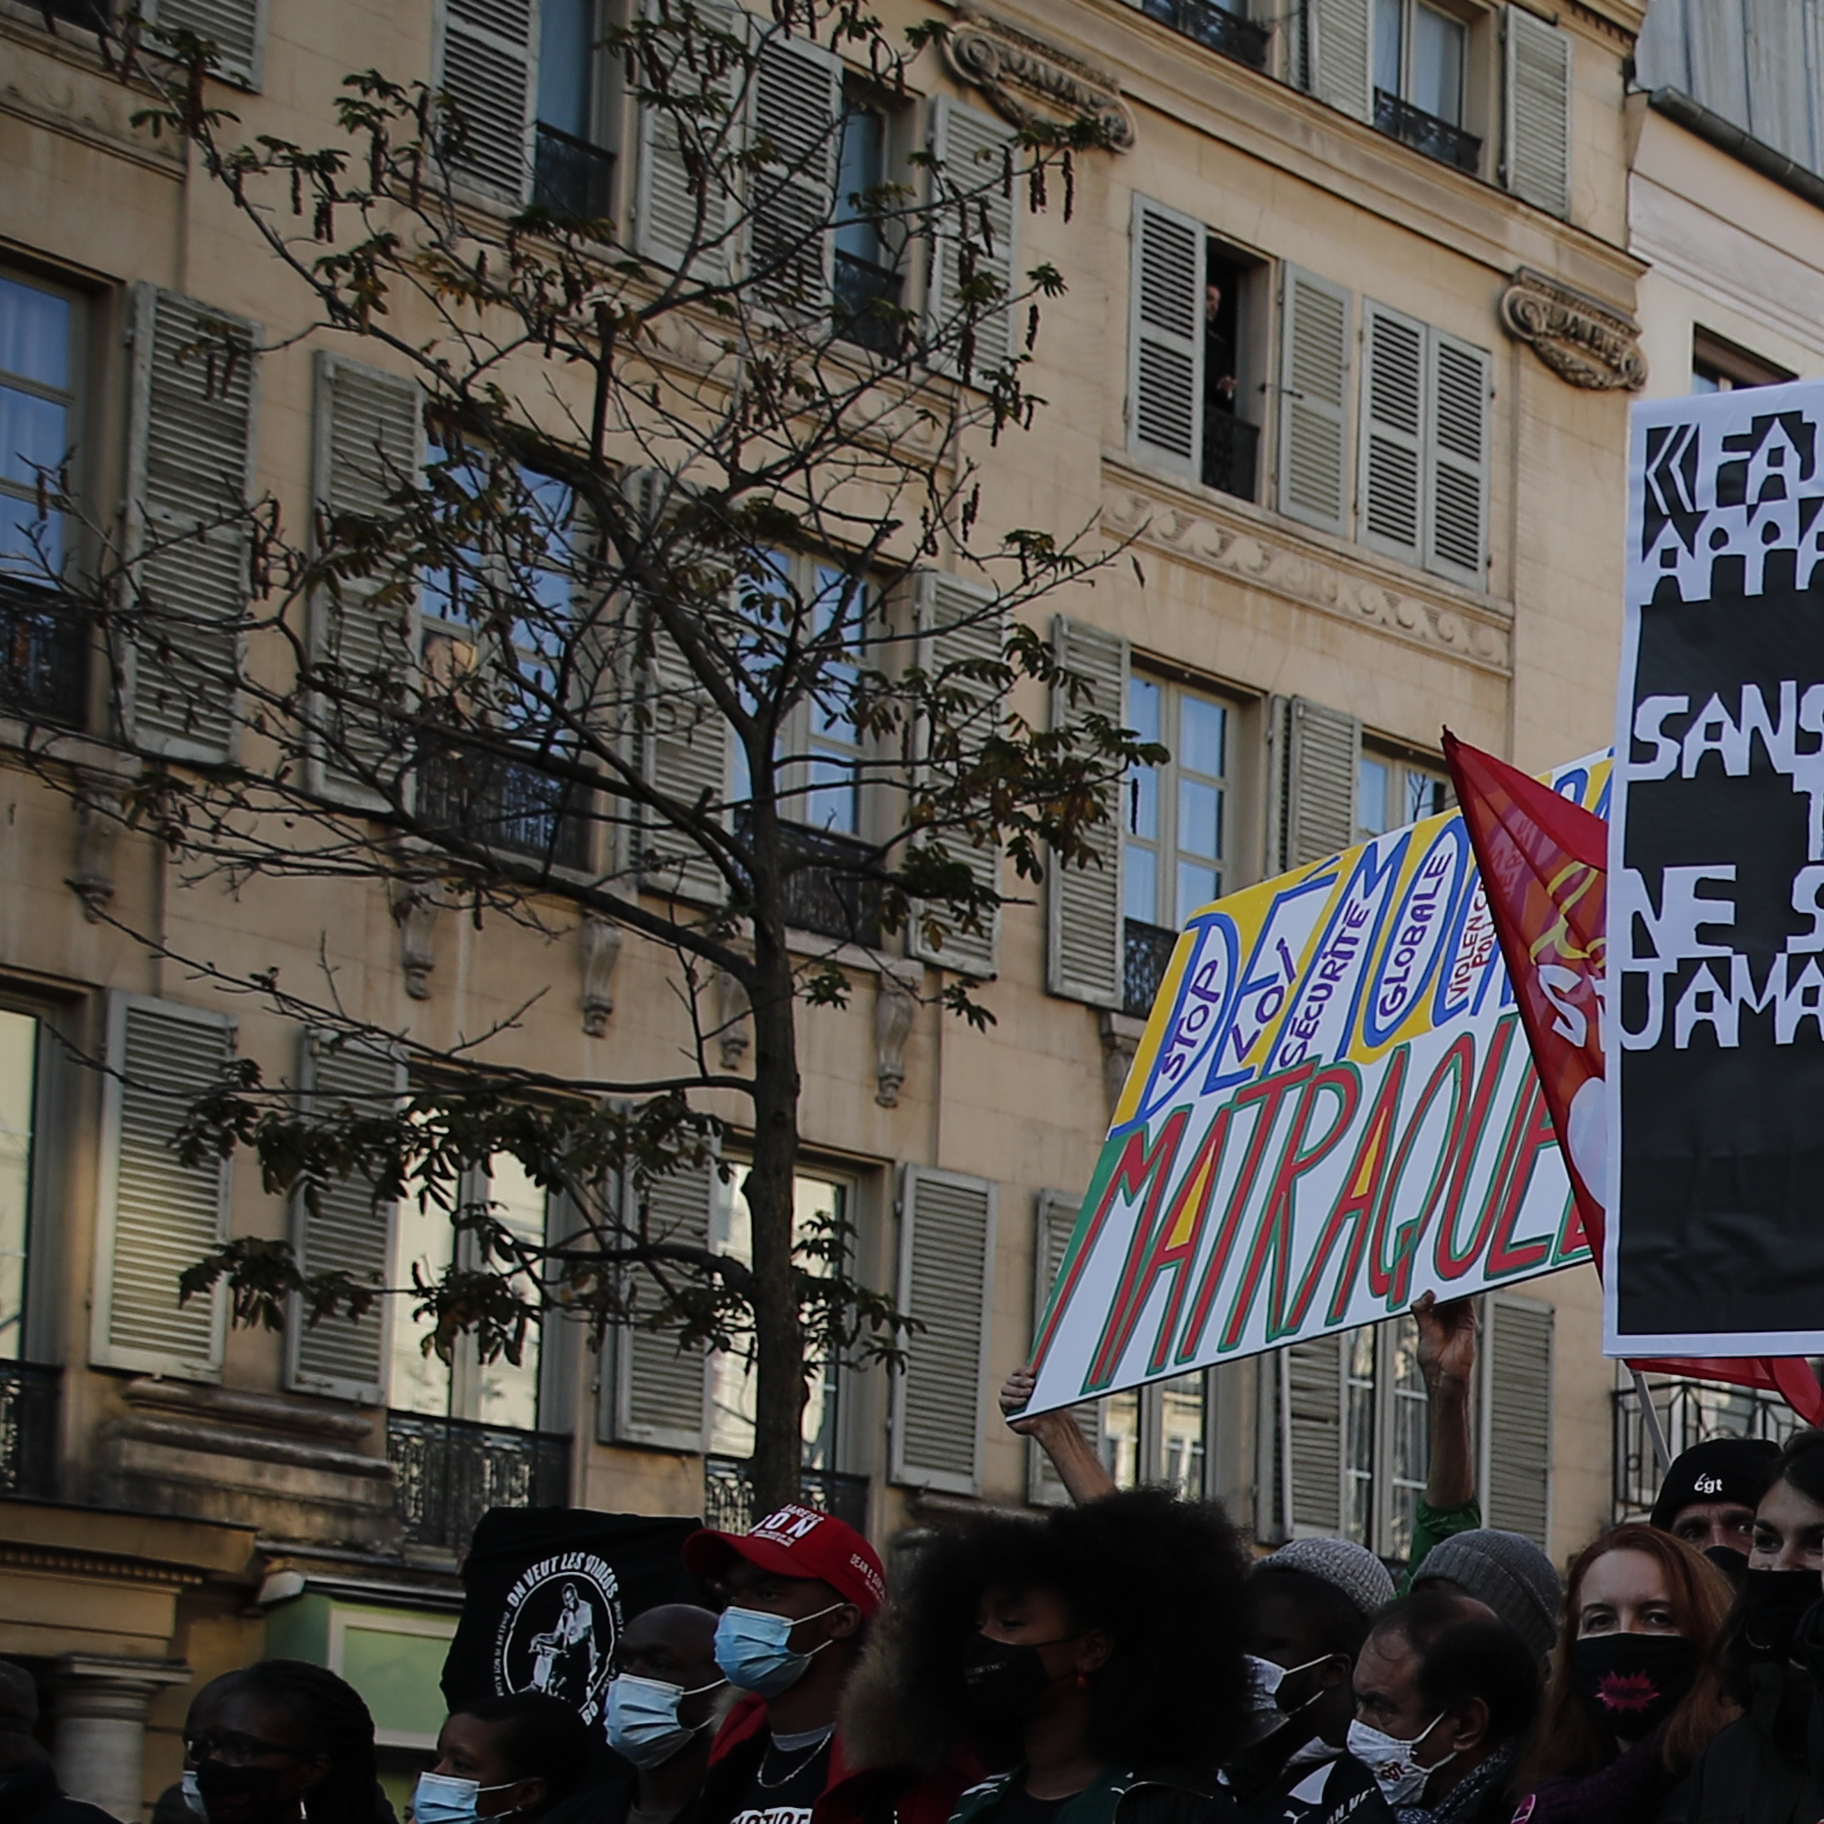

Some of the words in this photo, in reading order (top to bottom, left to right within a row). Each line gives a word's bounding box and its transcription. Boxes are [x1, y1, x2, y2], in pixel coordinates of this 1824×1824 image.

[1379, 852, 1456, 1018] GLOBALE
[1621, 864, 1736, 960] NE
[1160, 958, 1222, 1081] STOP
[1230, 936, 1297, 1064] LOI
[507, 1581, 528, 1609] ON
[522, 1555, 560, 1588] VEUT
[560, 1551, 586, 1571] LES
